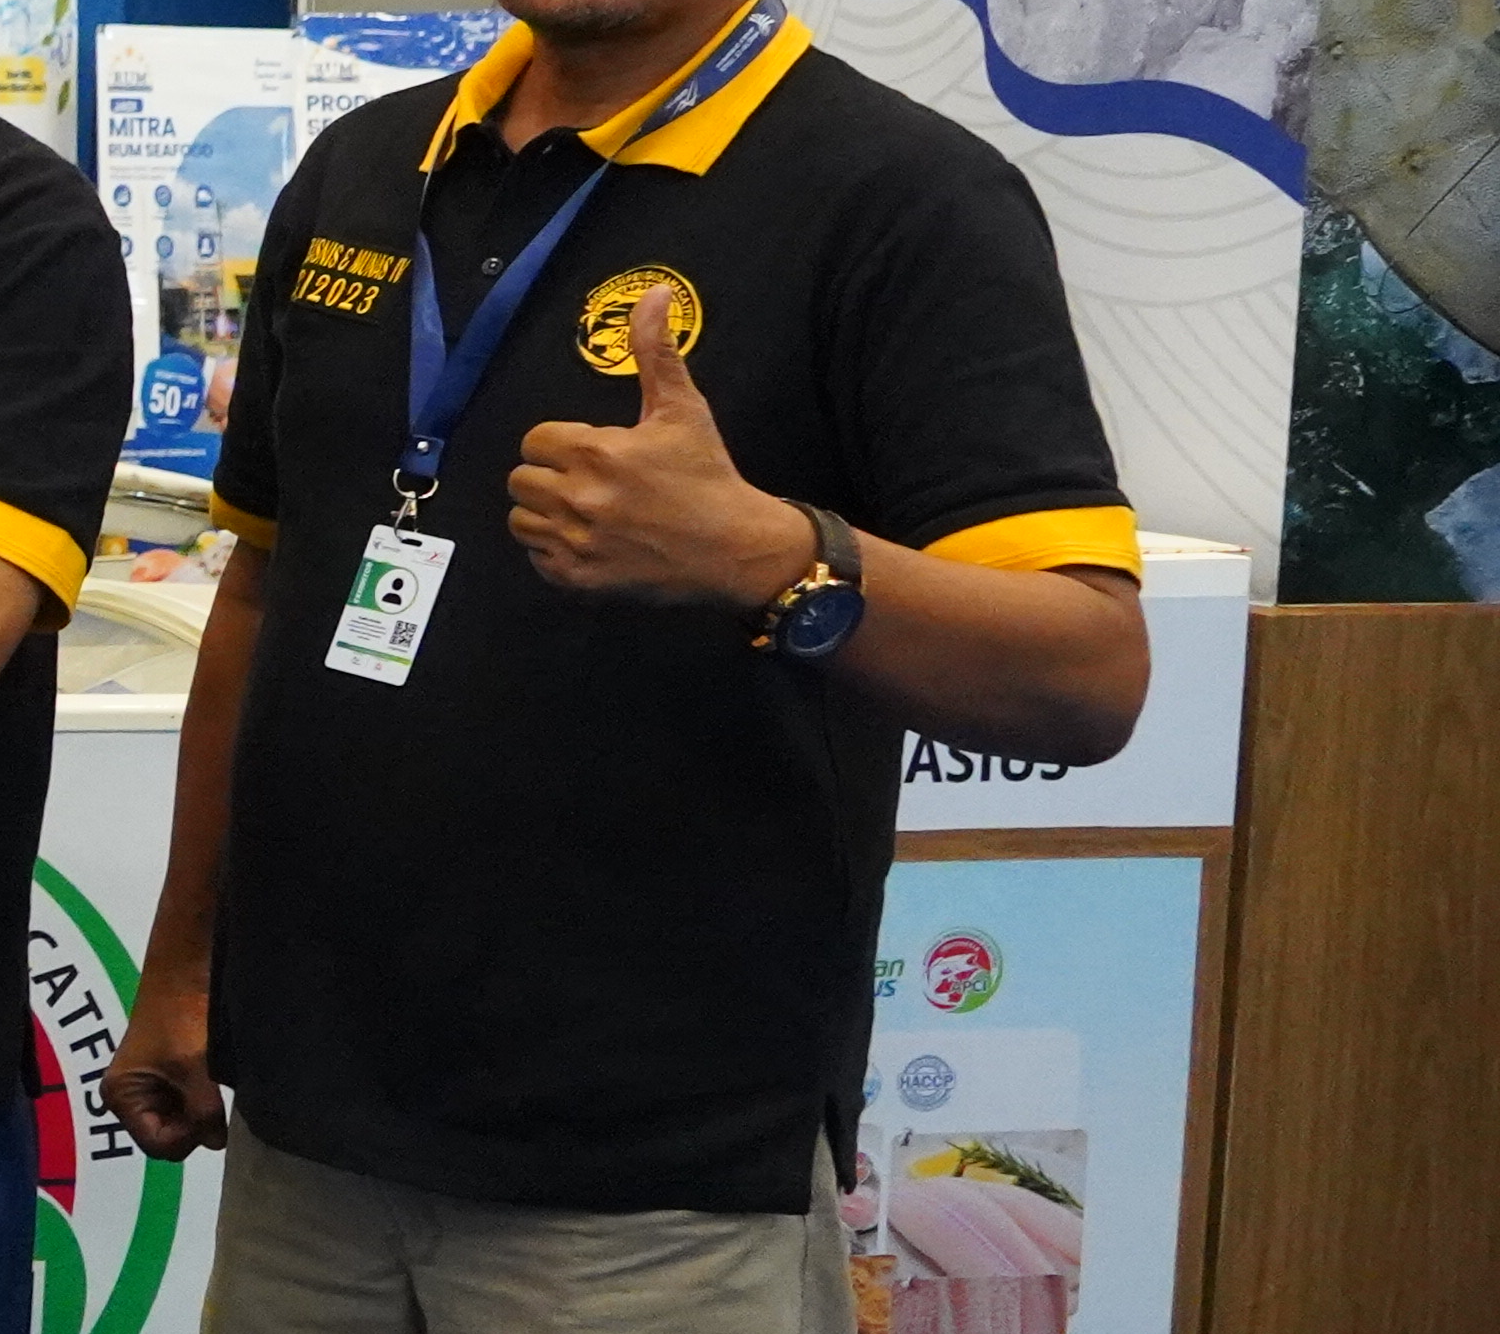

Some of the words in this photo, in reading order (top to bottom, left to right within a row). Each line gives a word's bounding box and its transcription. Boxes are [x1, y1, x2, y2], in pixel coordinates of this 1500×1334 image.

[307, 94, 372, 113] PROD
[108, 118, 176, 137] MITRA
[108, 144, 142, 158] RUM
[146, 143, 214, 158] SEAFOOD
[306, 274, 380, 315] 2023
[149, 382, 181, 417] 50
[950, 979, 988, 993] APCI
[900, 1074, 954, 1089] HACCP
